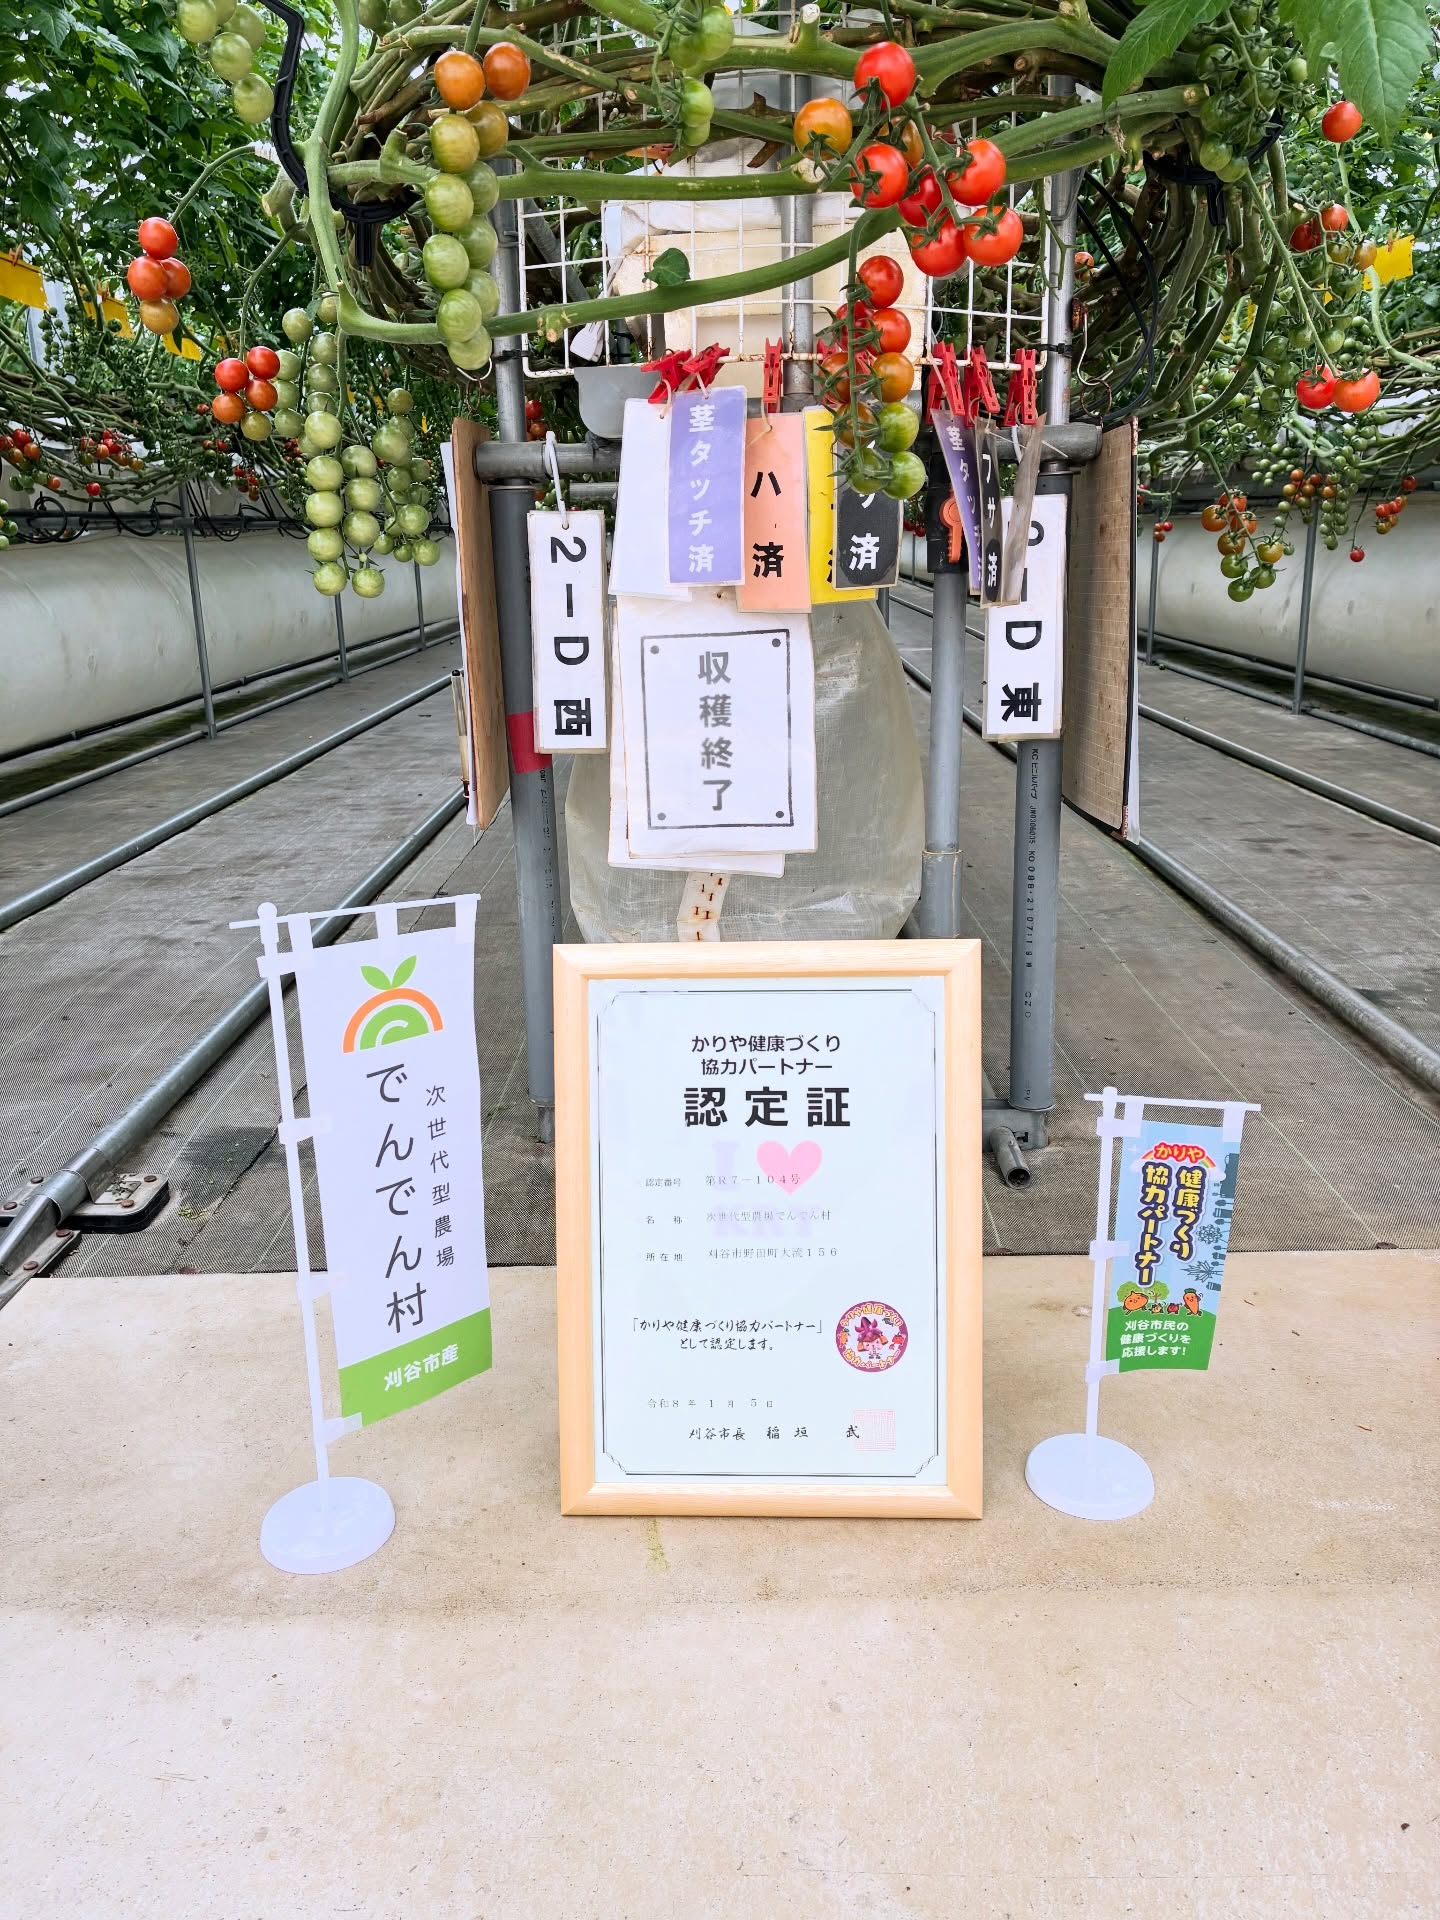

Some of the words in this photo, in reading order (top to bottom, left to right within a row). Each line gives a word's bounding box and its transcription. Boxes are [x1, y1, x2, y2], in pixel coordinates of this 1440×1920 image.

[689, 404, 715, 573] 茎タッチ済
[697, 650, 733, 811] 収穫終了
[690, 1034, 841, 1054] かりや健康づくり
[700, 1057, 833, 1076] 協力パートナー
[684, 1086, 851, 1128] 認定証
[425, 1084, 456, 1268] 次世代型農場
[1154, 1143, 1205, 1163] かりや
[366, 1063, 428, 1334] でんでん村
[1170, 1166, 1206, 1260] 健康づくり
[1136, 1163, 1170, 1284] 協力パートナー
[1119, 1332, 1192, 1346] 健康づくりを
[1124, 1319, 1189, 1332] 刈谷市民の
[383, 1343, 460, 1393] 刈谷市産
[688, 1427, 746, 1441] 刈谷市長
